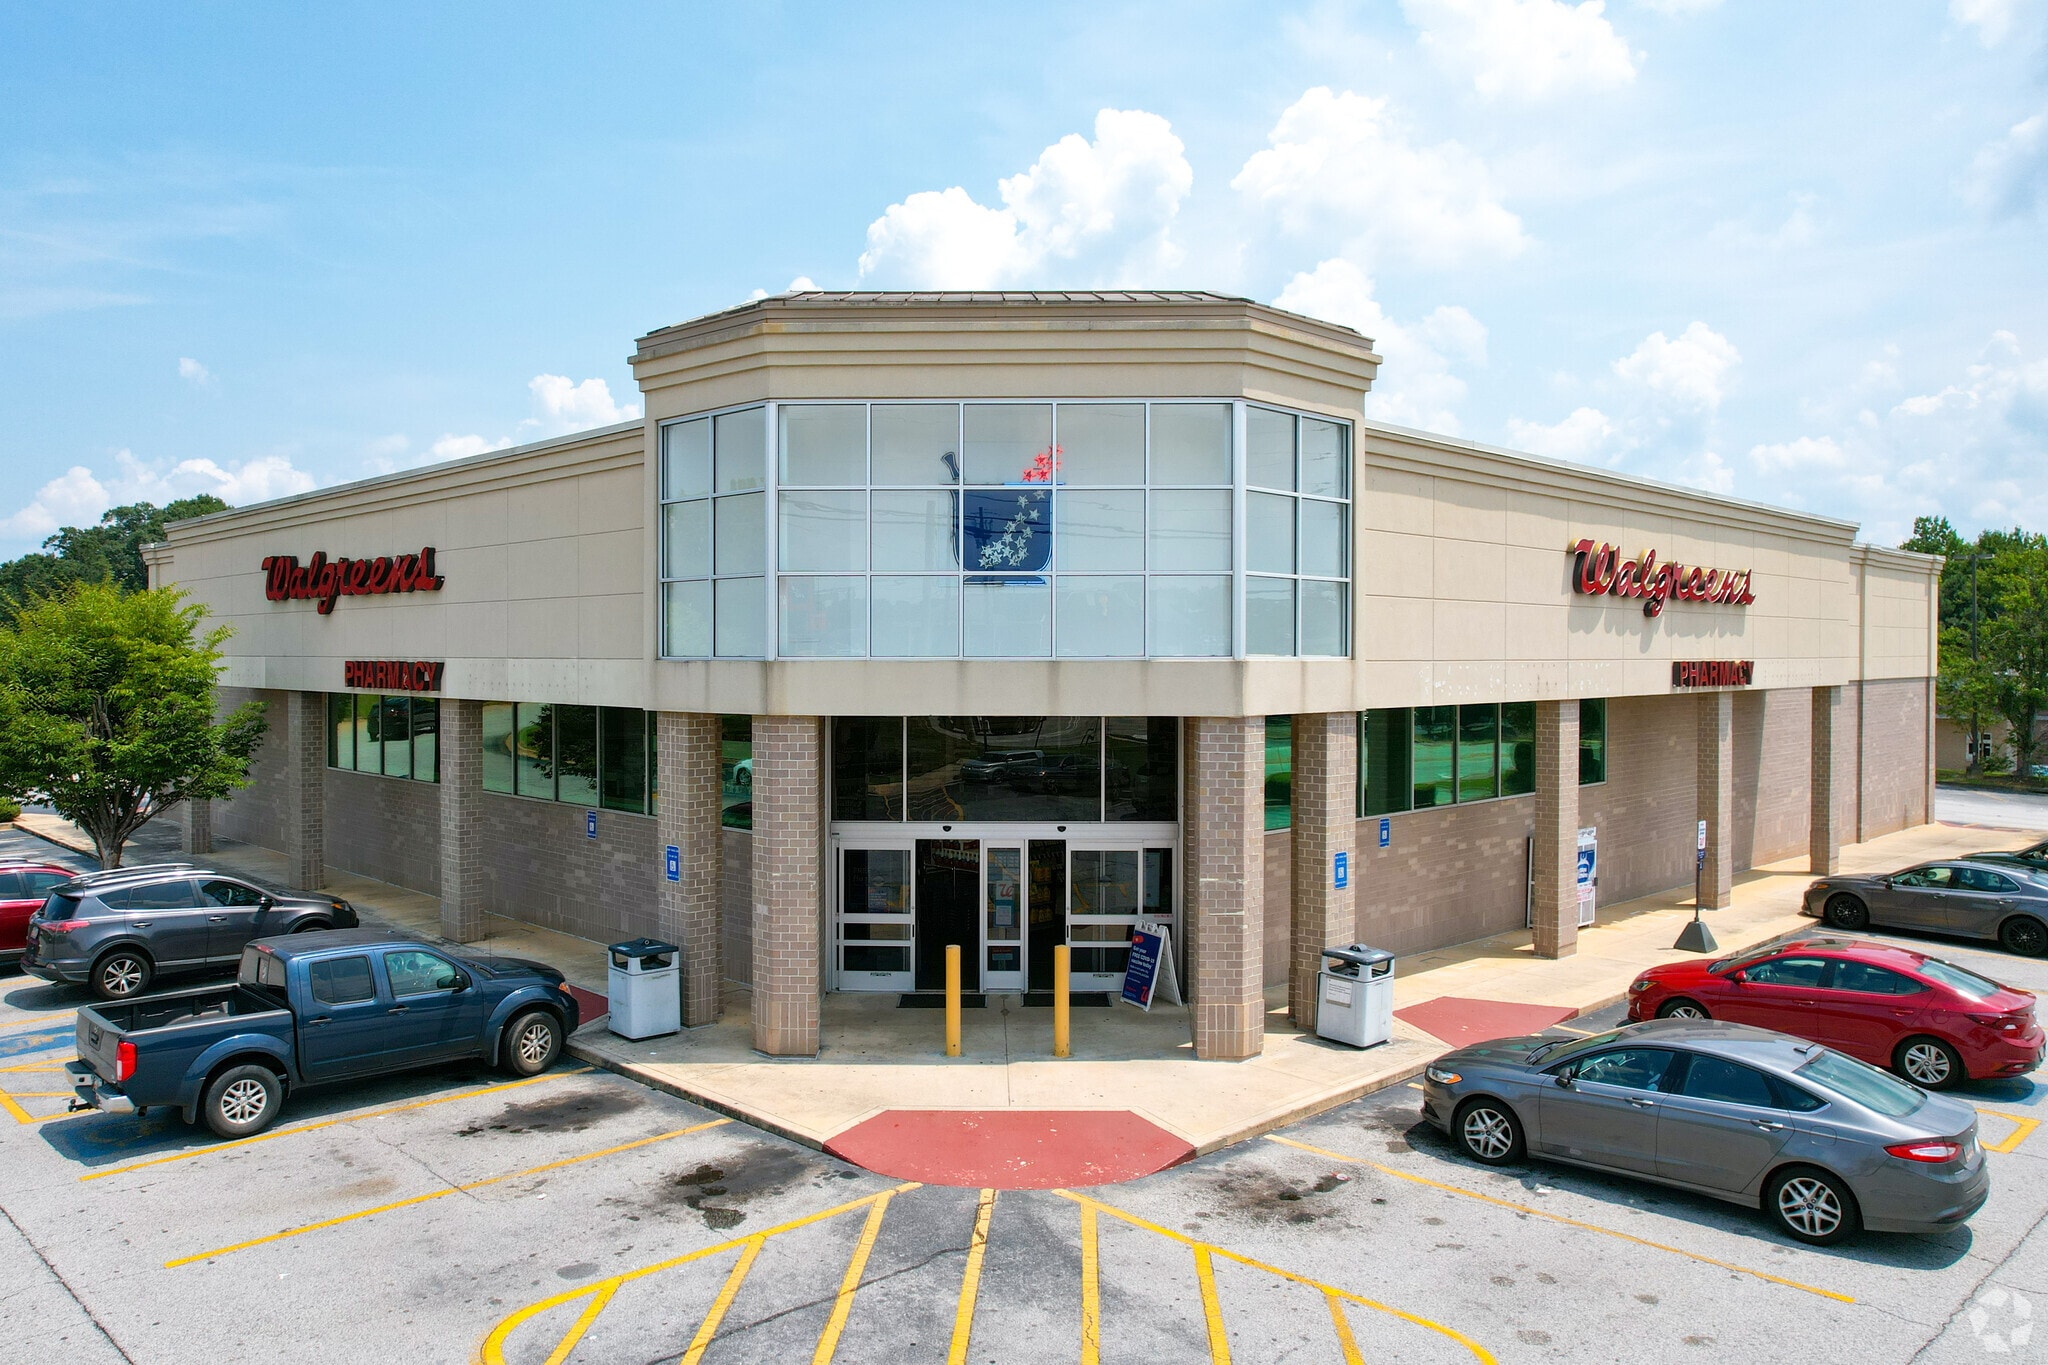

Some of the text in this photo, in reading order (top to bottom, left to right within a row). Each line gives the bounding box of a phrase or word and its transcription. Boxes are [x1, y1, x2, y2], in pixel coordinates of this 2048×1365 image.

[261, 547, 446, 615] Walgreens
[1566, 537, 1757, 618] Walgreens
[344, 660, 445, 692] PHARMACY
[1672, 660, 1755, 688] PHARMACY
